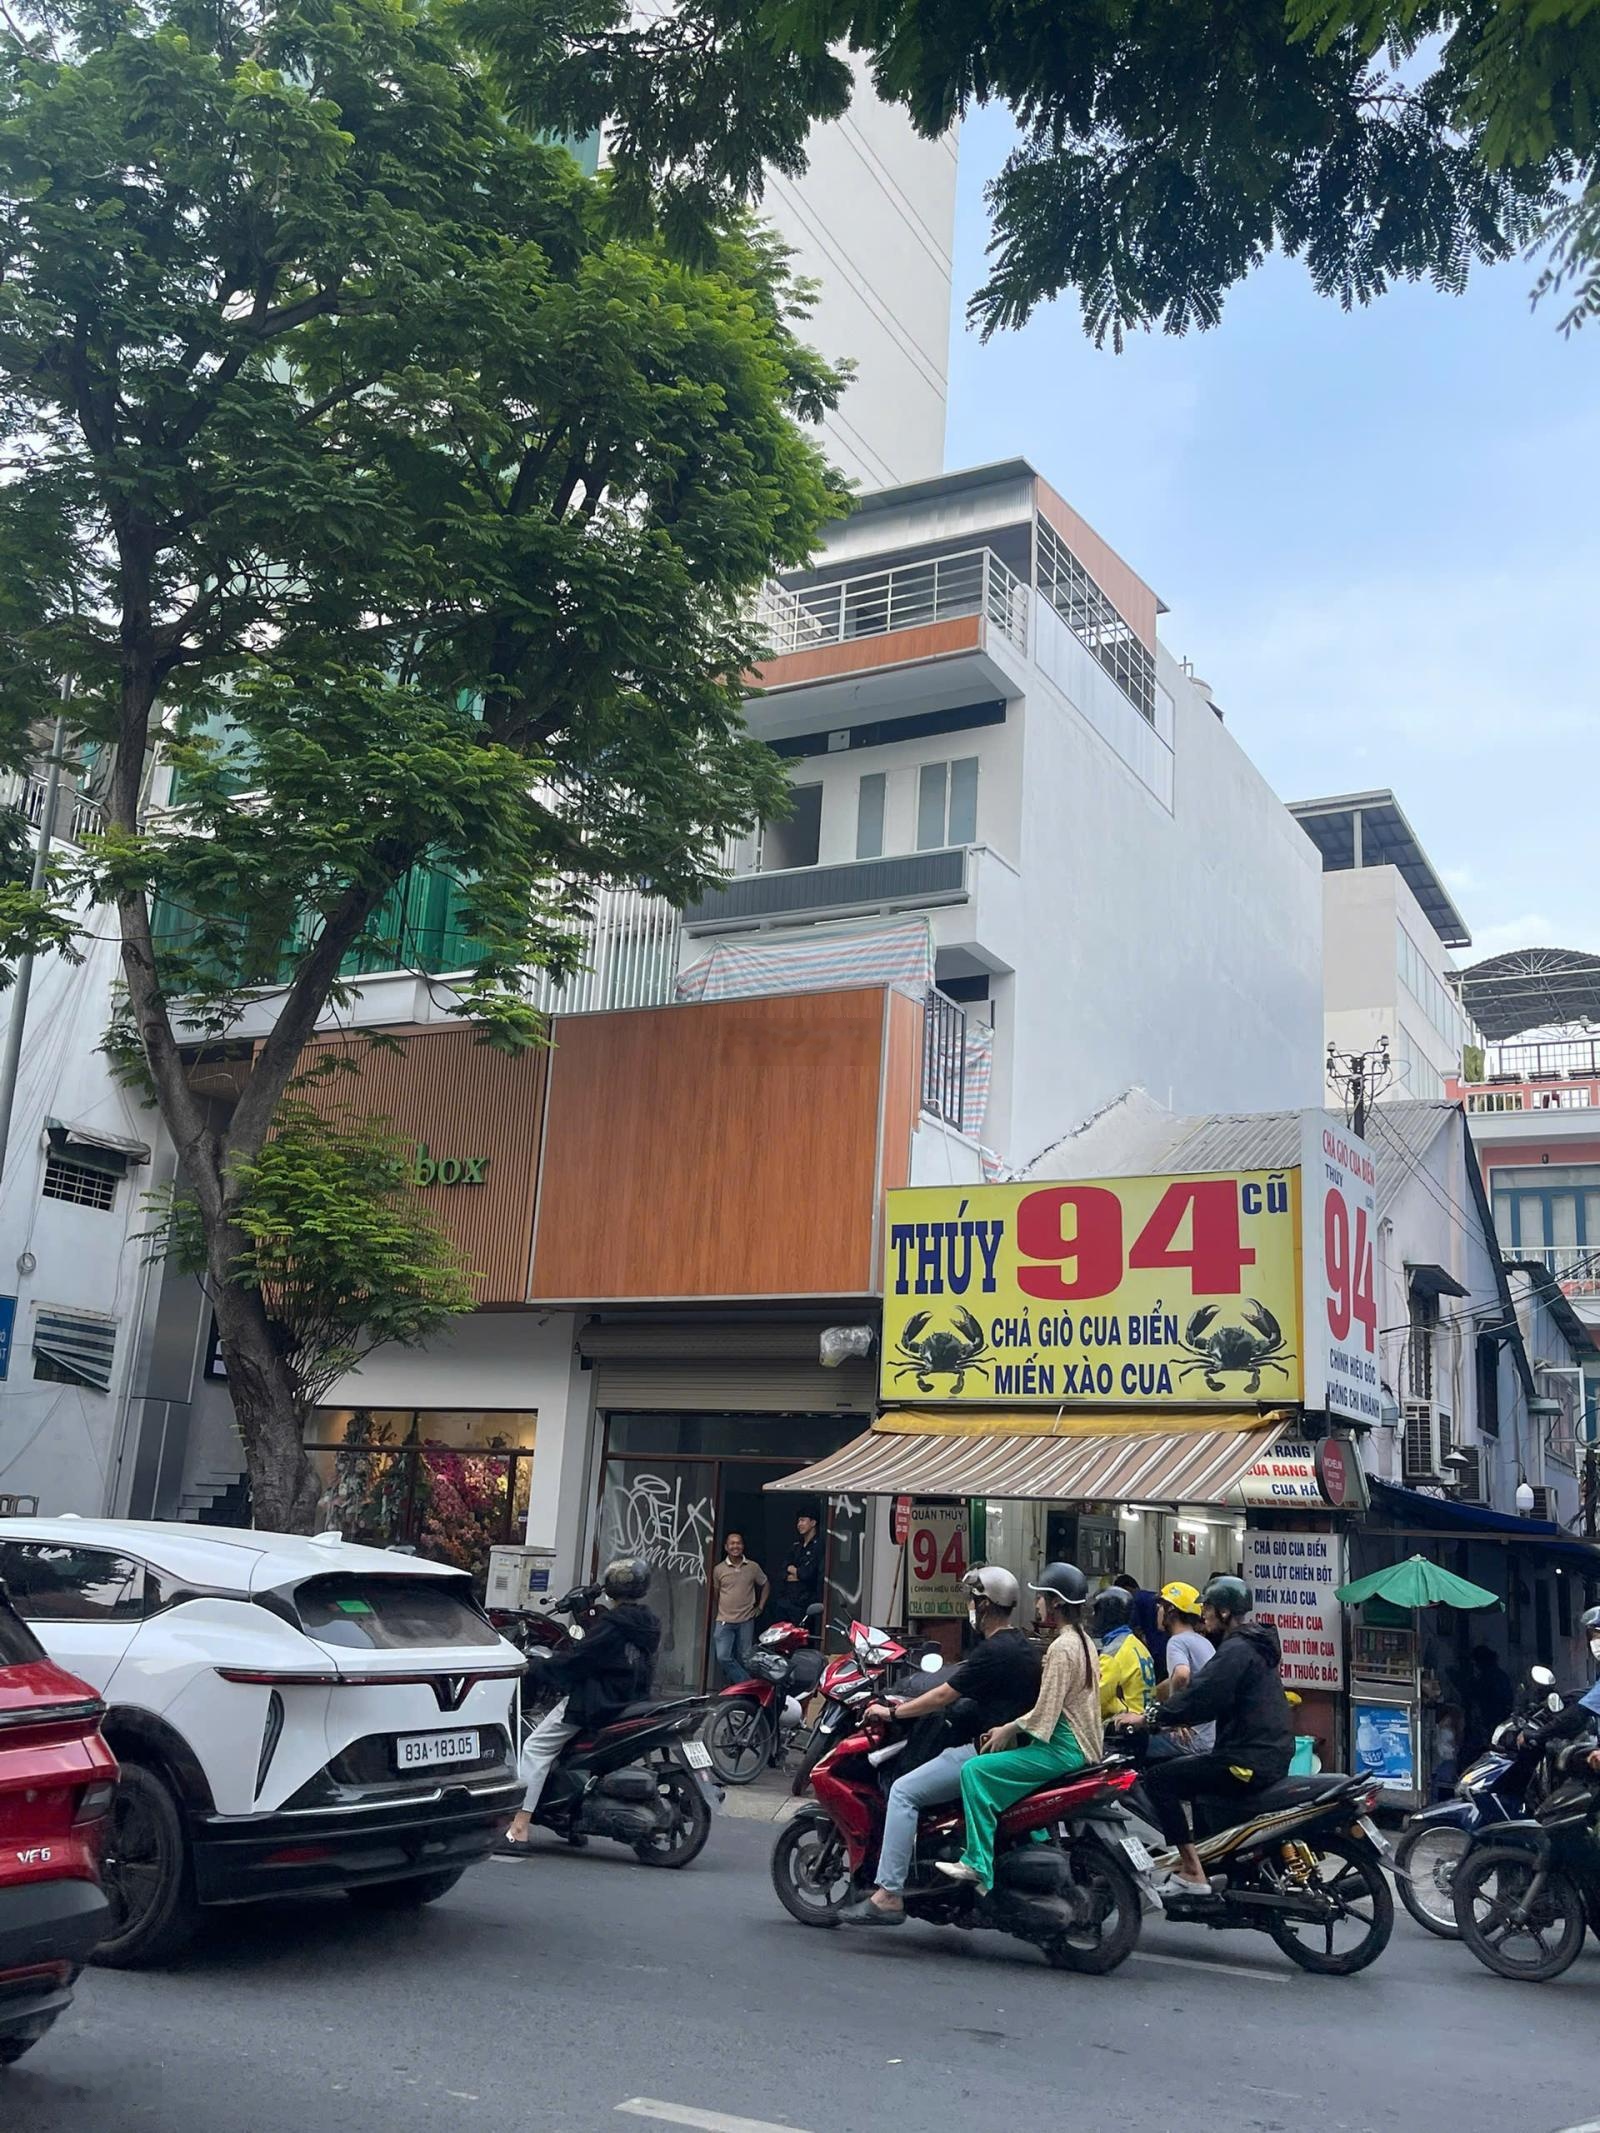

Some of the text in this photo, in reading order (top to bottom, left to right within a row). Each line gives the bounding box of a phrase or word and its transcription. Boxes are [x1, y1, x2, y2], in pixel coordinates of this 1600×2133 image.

[415, 1142, 488, 1186] box
[891, 1199, 1004, 1295] THÚY
[1017, 1180, 1256, 1300] 94
[1324, 1188, 1377, 1354] 94
[991, 1299, 1178, 1348] CHẢ GIÒ CUA BIỂN
[995, 1352, 1173, 1395] MIẾN XÀO CUA
[1275, 1445, 1310, 1458] RANG
[1272, 1465, 1308, 1477] RANG
[1271, 1483, 1297, 1496] CUA
[1301, 1480, 1319, 1496] HẤ
[912, 1529, 967, 1582] 94
[1254, 1536, 1270, 1554] CHẢ
[1273, 1538, 1287, 1556] GIÒ
[1289, 1542, 1305, 1557] CUA
[1254, 1564, 1271, 1578] CUA
[1255, 1585, 1317, 1606] MIẾN XÀO CUA
[1306, 1616, 1324, 1631] CUA
[1320, 1641, 1335, 1657] CUA
[1294, 1661, 1320, 1681] THUỐC
[16, 1847, 51, 1863] VF6
